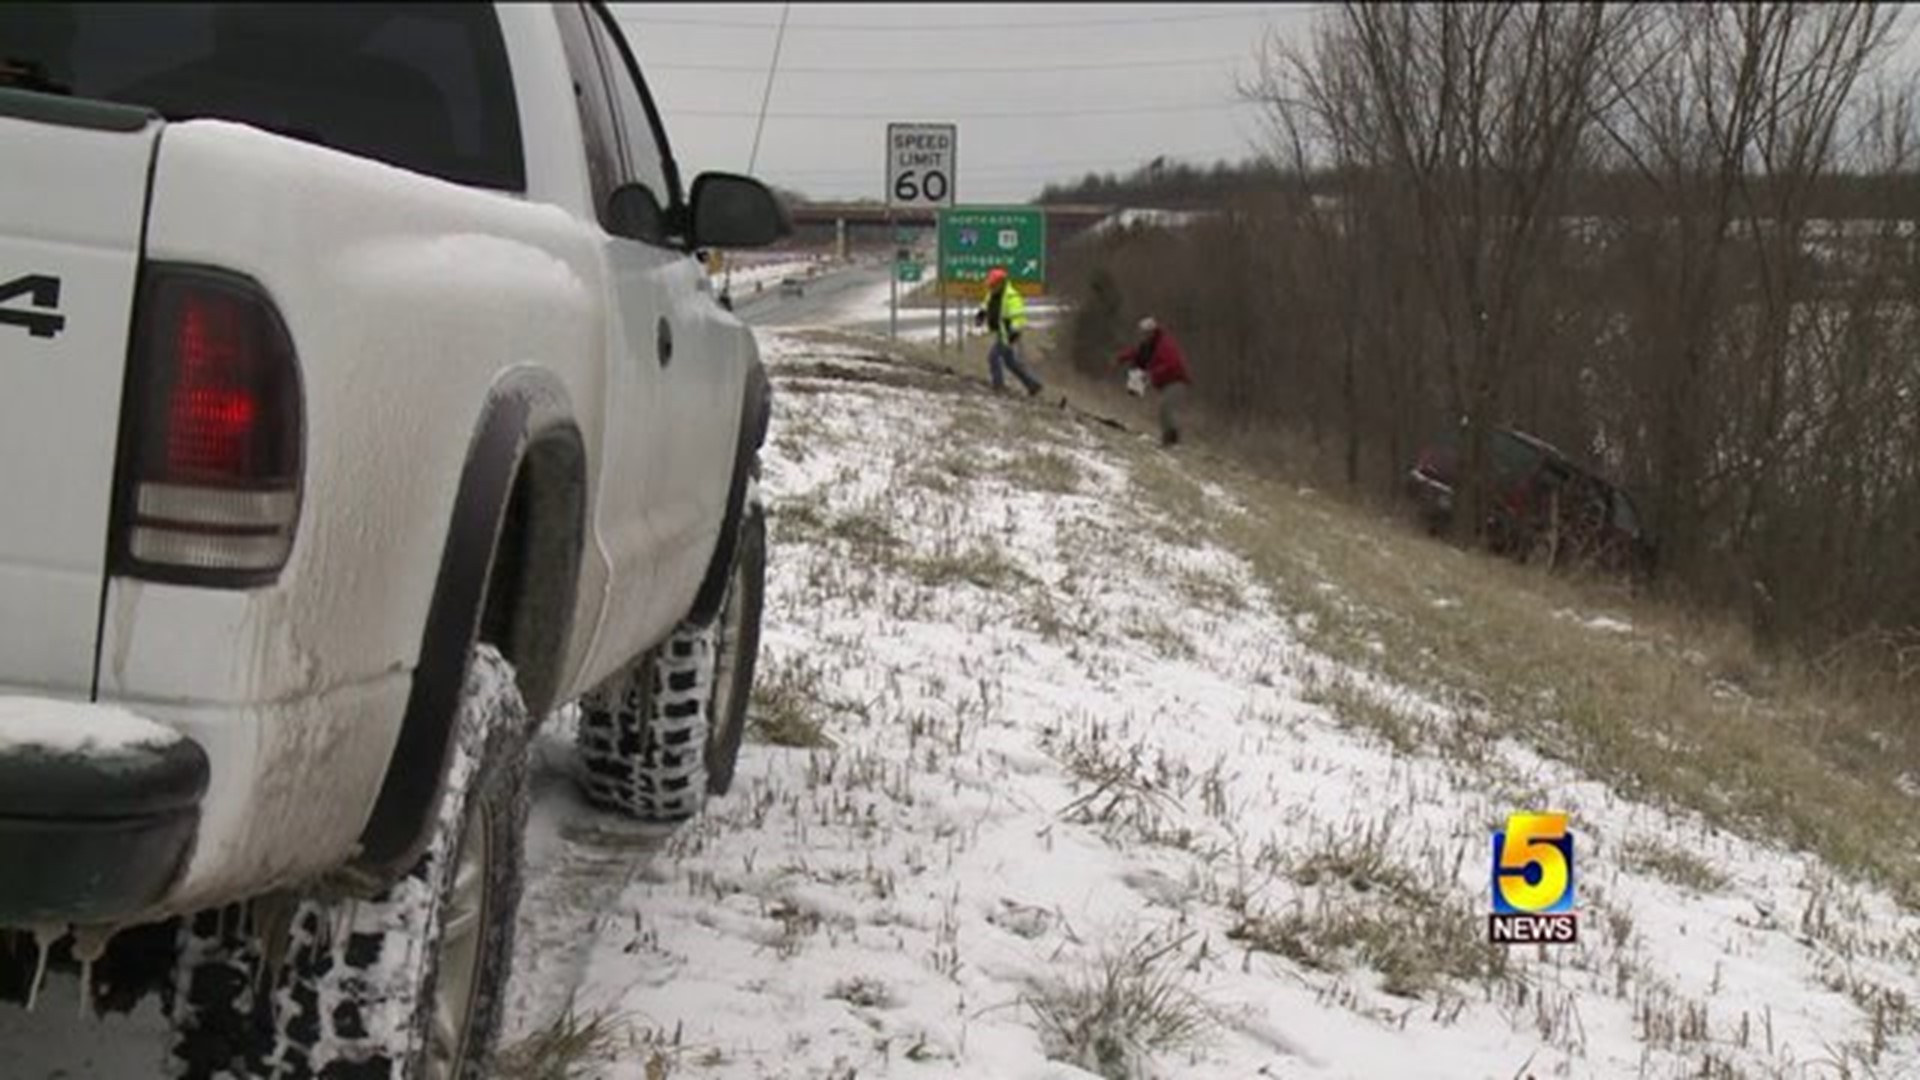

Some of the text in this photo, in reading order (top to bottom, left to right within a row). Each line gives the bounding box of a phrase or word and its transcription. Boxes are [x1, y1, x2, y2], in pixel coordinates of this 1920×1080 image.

[894, 134, 949, 149] SPEED
[899, 152, 941, 167] LIMIT
[895, 170, 947, 201] 60
